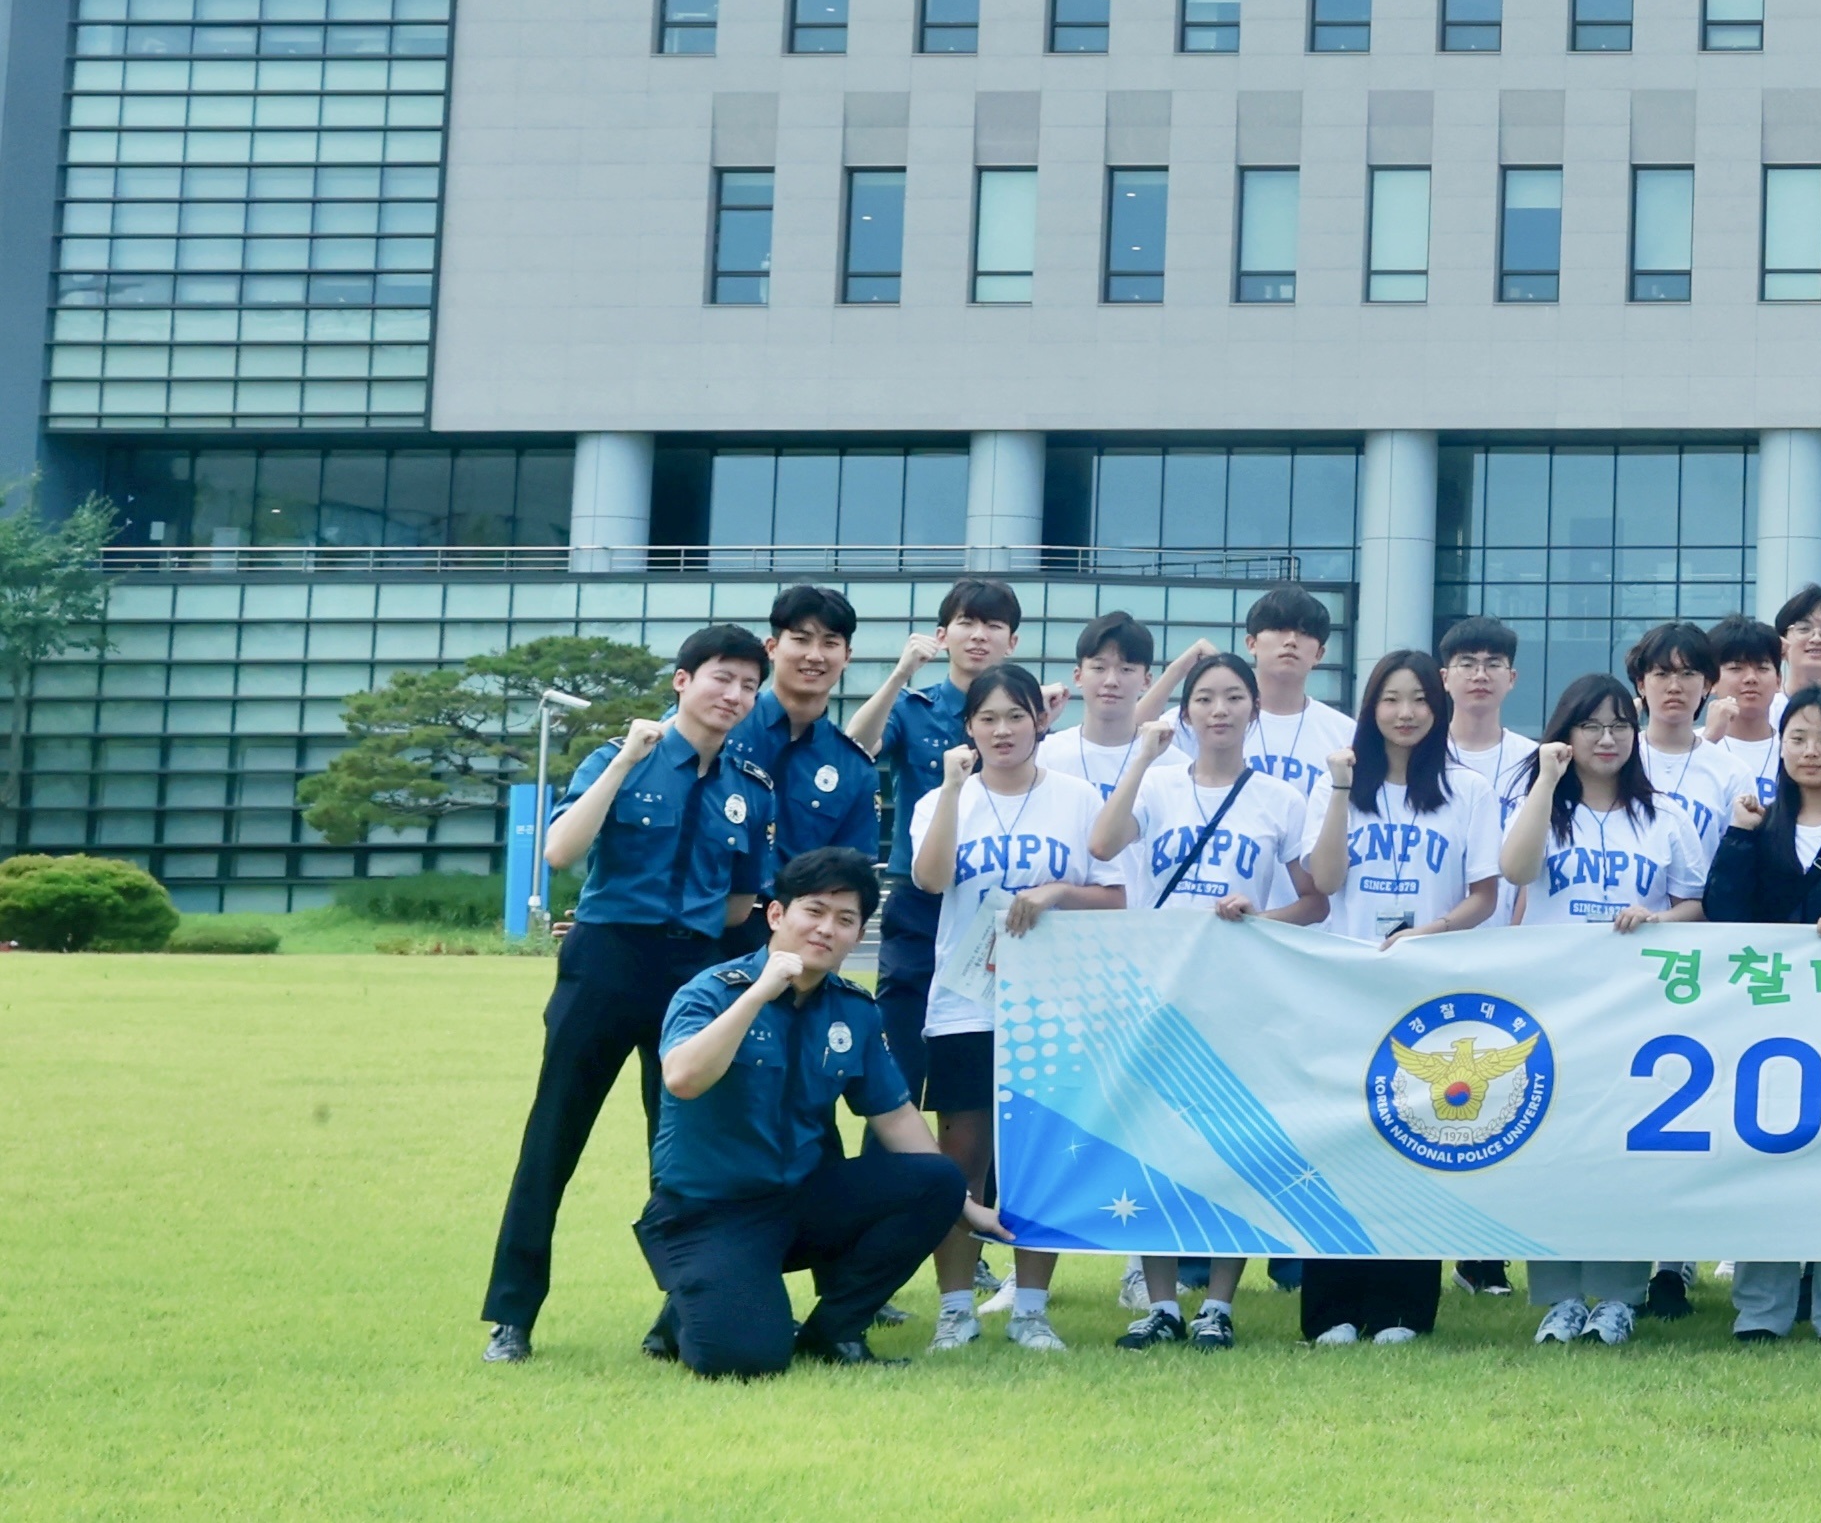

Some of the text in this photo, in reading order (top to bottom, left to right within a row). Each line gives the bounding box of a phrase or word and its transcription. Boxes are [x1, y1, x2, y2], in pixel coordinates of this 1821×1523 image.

[955, 834, 1071, 887] KNPU
[1346, 823, 1449, 874] KNPU
[1546, 847, 1658, 899] KNPU
[1363, 879, 1391, 892] SINCE
[1573, 902, 1602, 914] SINCE
[1375, 1072, 1545, 1164] KOREAN NATIONAL POLICE UNIVERSITY
[1443, 1131, 1470, 1142] 1979
